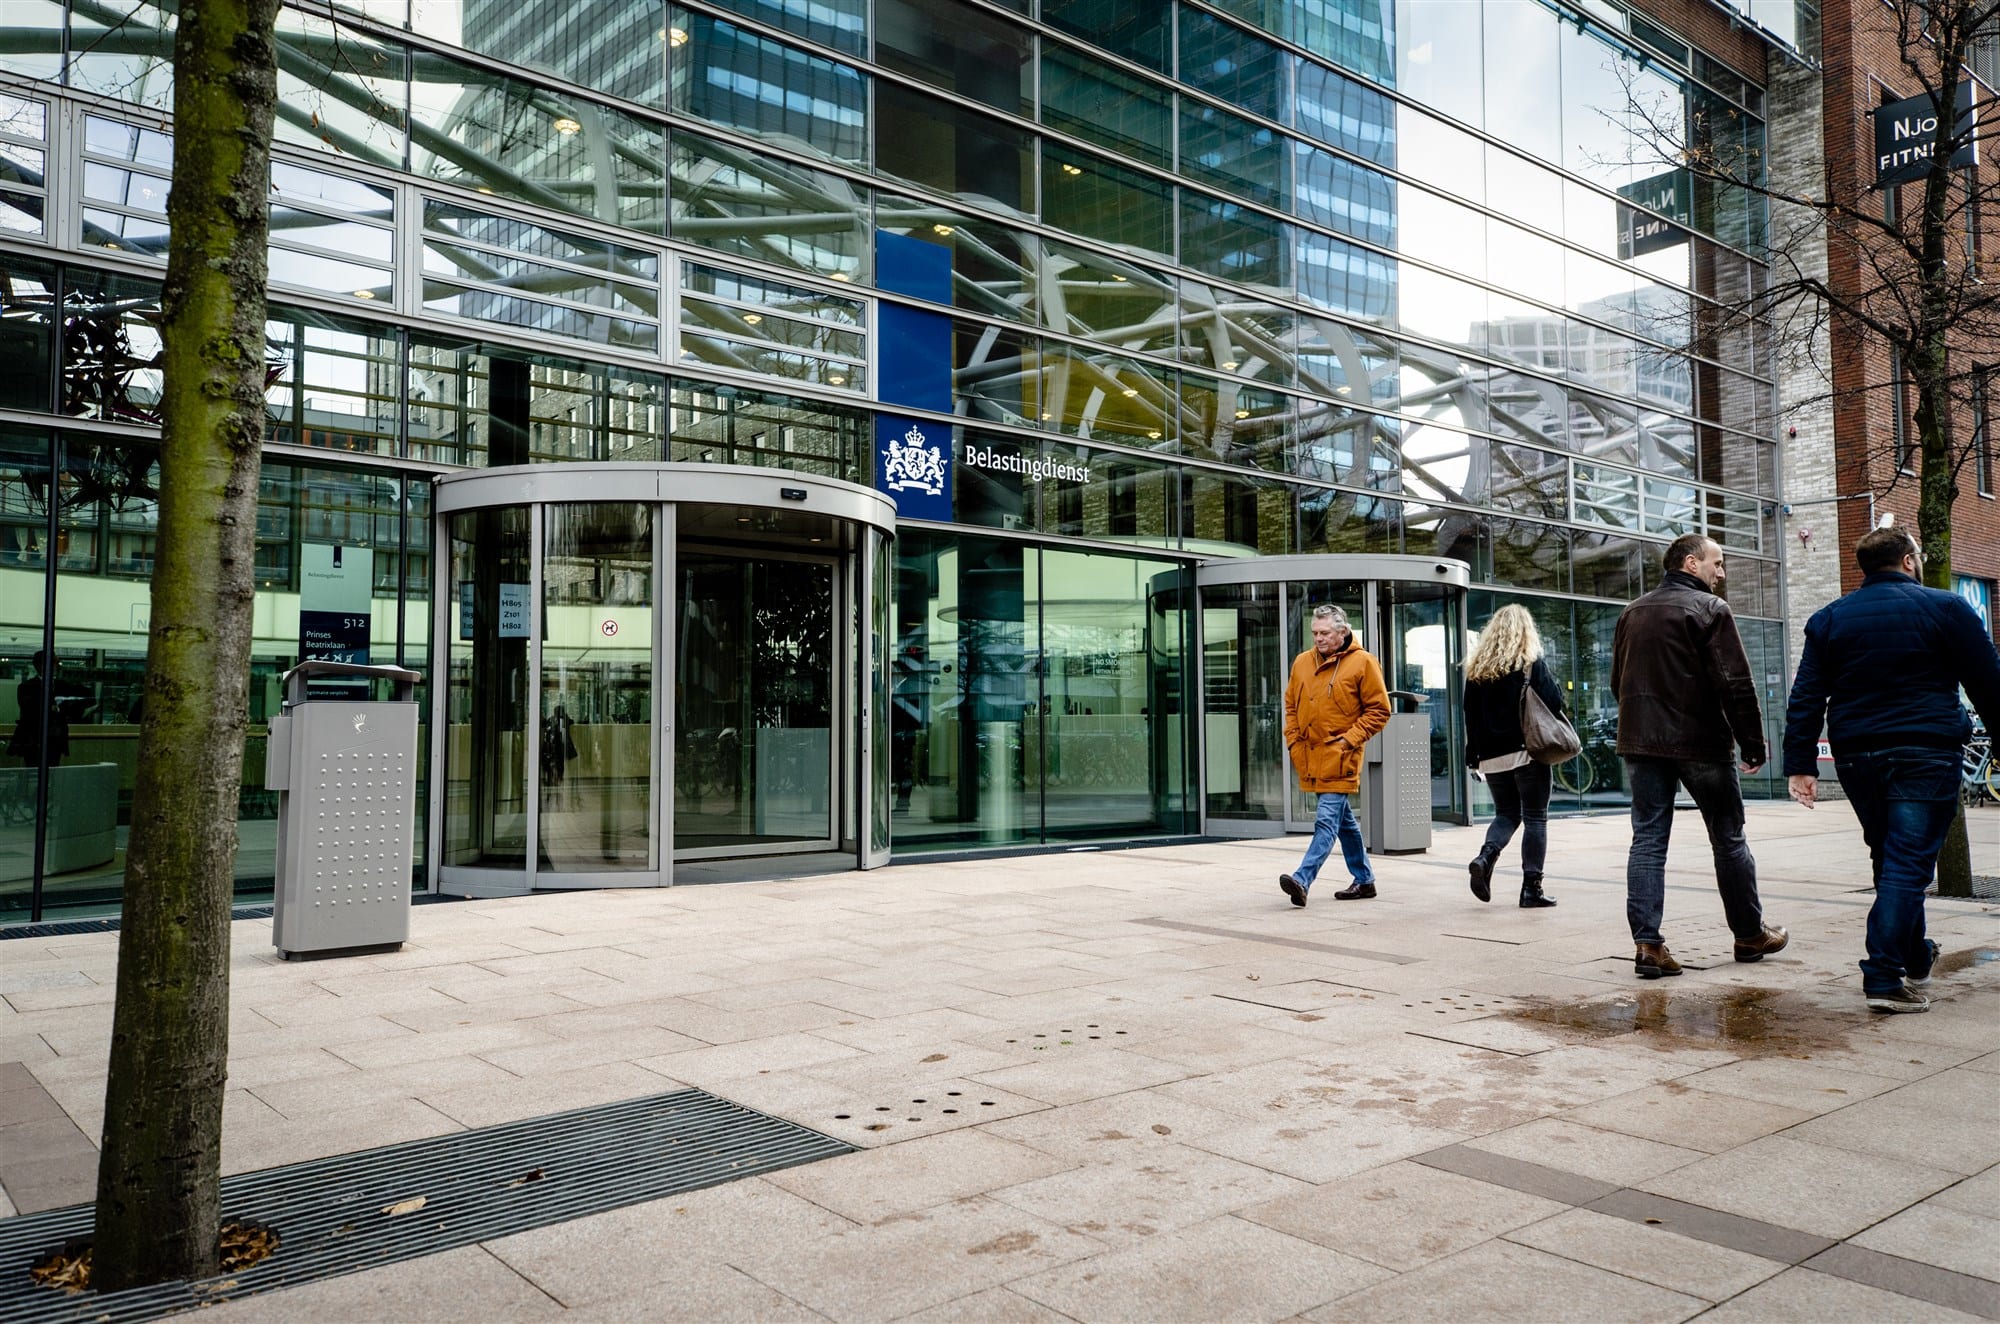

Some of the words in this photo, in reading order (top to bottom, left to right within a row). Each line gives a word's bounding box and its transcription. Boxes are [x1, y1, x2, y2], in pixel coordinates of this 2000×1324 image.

[965, 445, 1090, 483] Belastingdienst
[344, 618, 365, 629] 512
[306, 630, 331, 638] Prinses
[306, 641, 345, 649] Beatrixlaan
